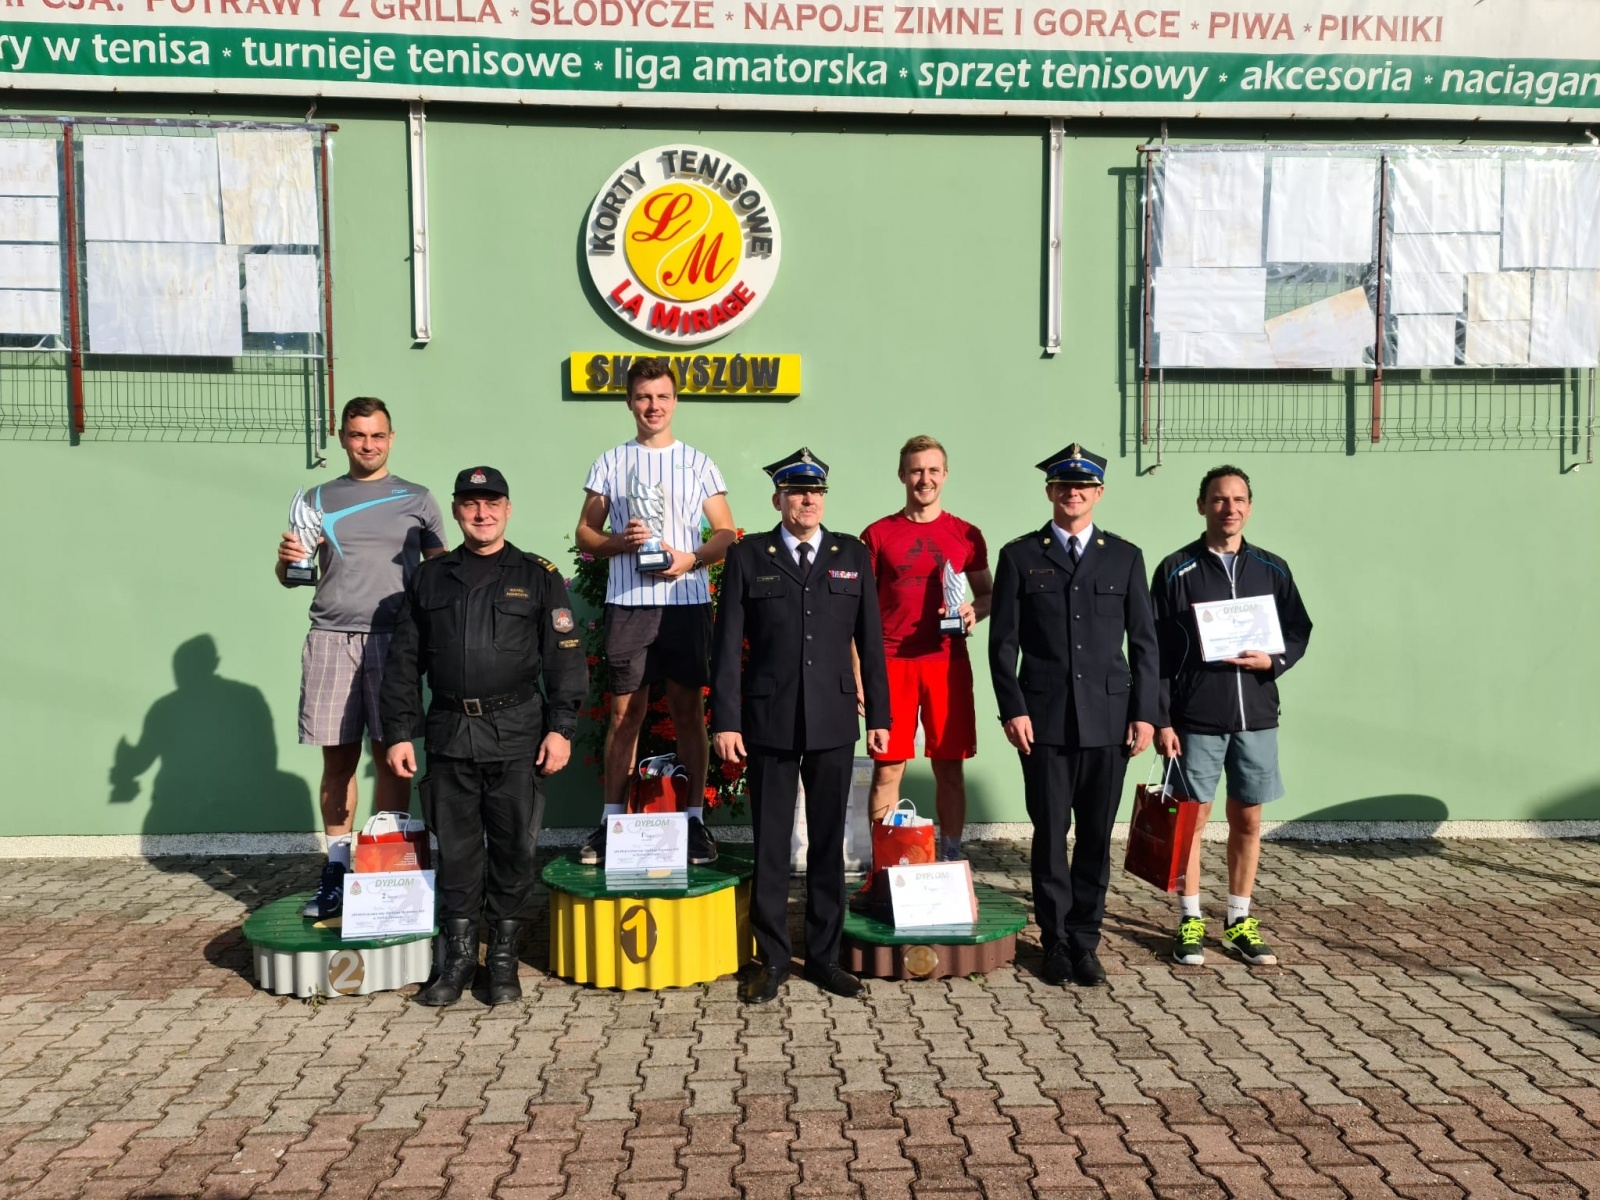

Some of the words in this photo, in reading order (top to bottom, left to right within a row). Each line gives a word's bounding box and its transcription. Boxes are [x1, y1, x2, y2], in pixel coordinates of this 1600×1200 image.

[339, 0, 360, 18] Z
[371, 0, 502, 24] GRILLA
[530, 0, 715, 30] SŁODYCZE
[744, 2, 884, 34] NAPOJE
[895, 6, 1003, 36] ZIMNE
[1015, 9, 1022, 36] I
[1033, 9, 1180, 43] GORĄCE
[1208, 12, 1294, 41] PIWA
[1318, 16, 1443, 42] PIKNIKI
[43, 36, 81, 62] w
[92, 33, 210, 65] tenisa
[242, 37, 396, 80] turnieje
[407, 42, 582, 78] tenisowe
[614, 47, 681, 90] liga
[692, 52, 888, 86] amatorska
[918, 58, 1032, 96] sprzęt
[1041, 57, 1209, 101] tenisowy
[1240, 60, 1413, 92] akcesoria
[1441, 63, 1600, 105] naciągan
[592, 160, 647, 254] KORTY
[661, 149, 774, 257] TENISOWE
[610, 278, 646, 319] LA
[590, 353, 782, 390] SKYSZÓW
[1222, 603, 1257, 615] DYPLOM
[634, 818, 671, 828] DYPLOM
[374, 877, 415, 888] DYPLOM
[622, 908, 648, 959] 1
[330, 950, 363, 991] 2
[912, 945, 931, 975] 3
